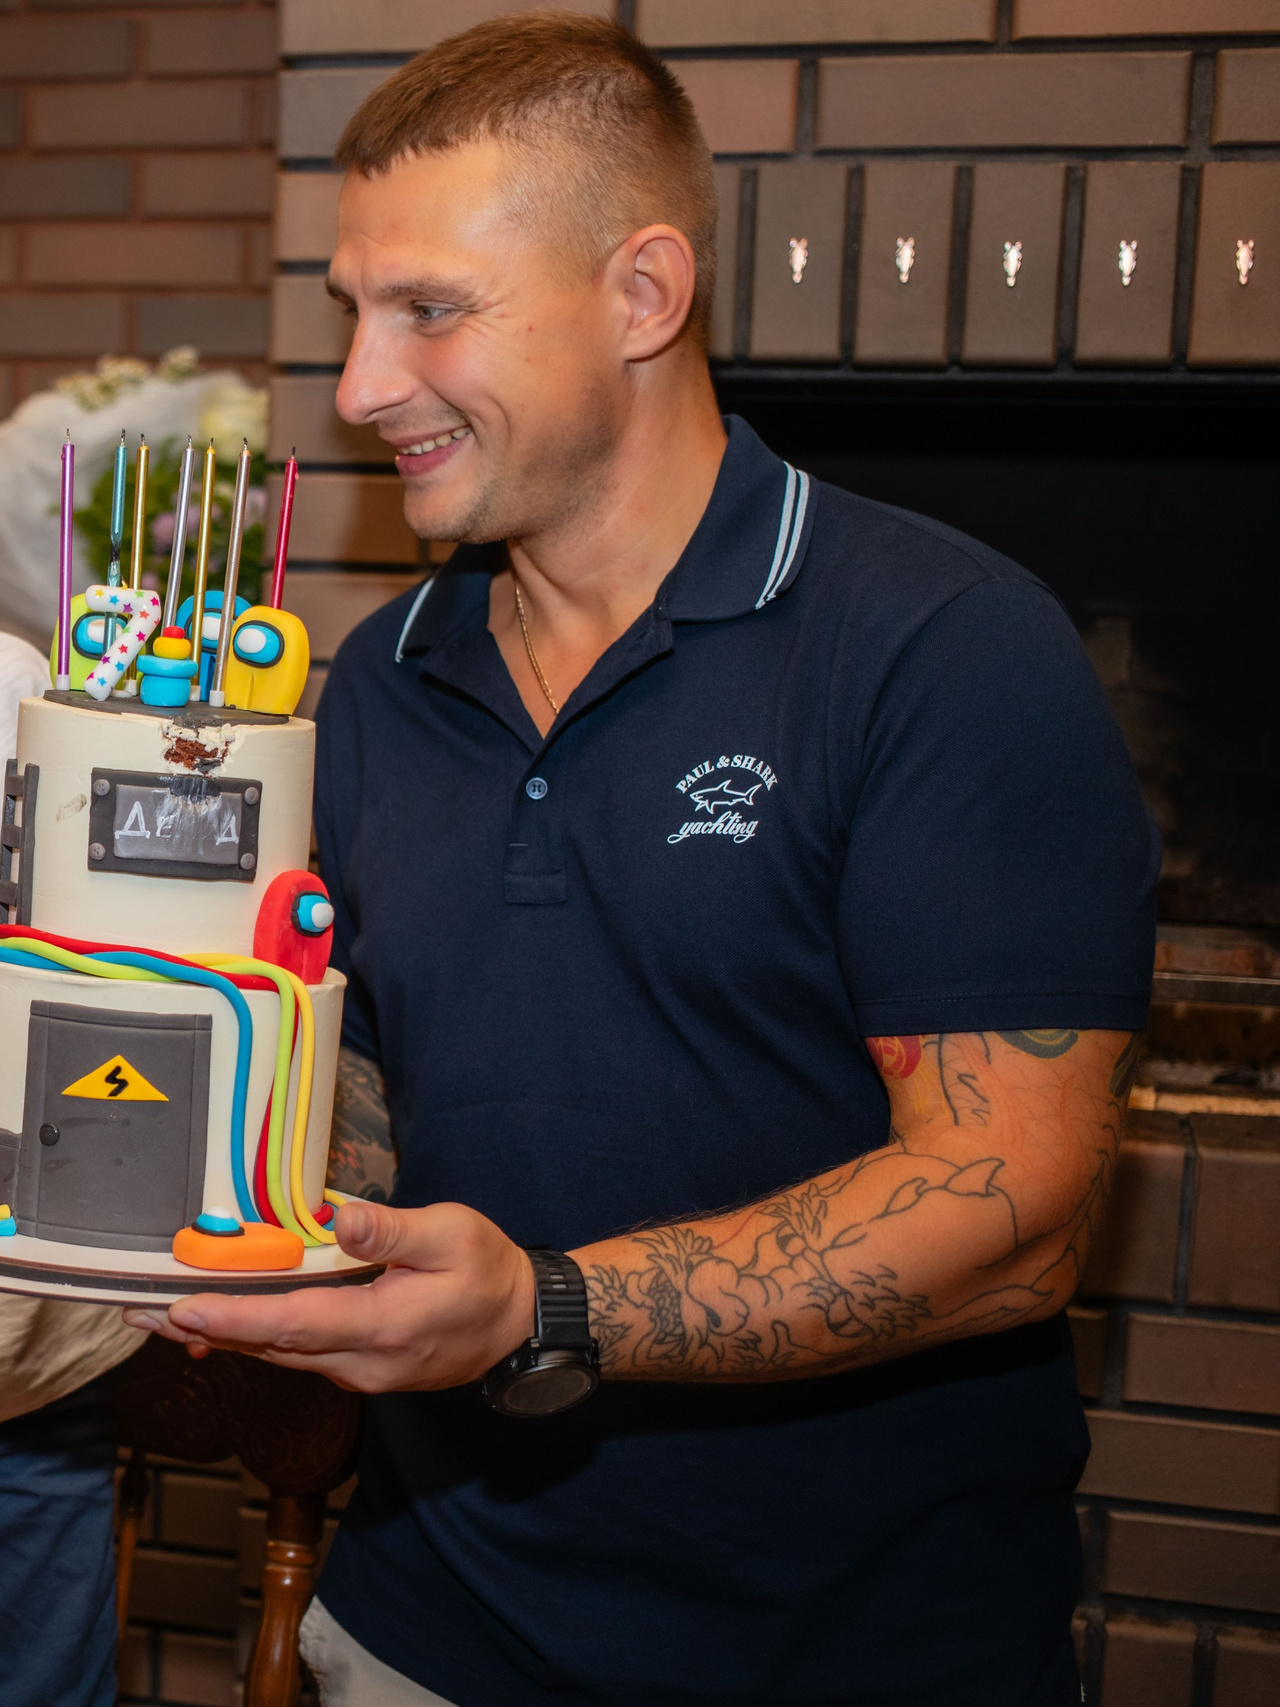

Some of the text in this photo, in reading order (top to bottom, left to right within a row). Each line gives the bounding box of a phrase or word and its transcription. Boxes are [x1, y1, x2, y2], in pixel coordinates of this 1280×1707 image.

[84, 584, 161, 701] 7
[676, 754, 778, 793] PAUL & SHARK
[667, 811, 759, 844] yachting
